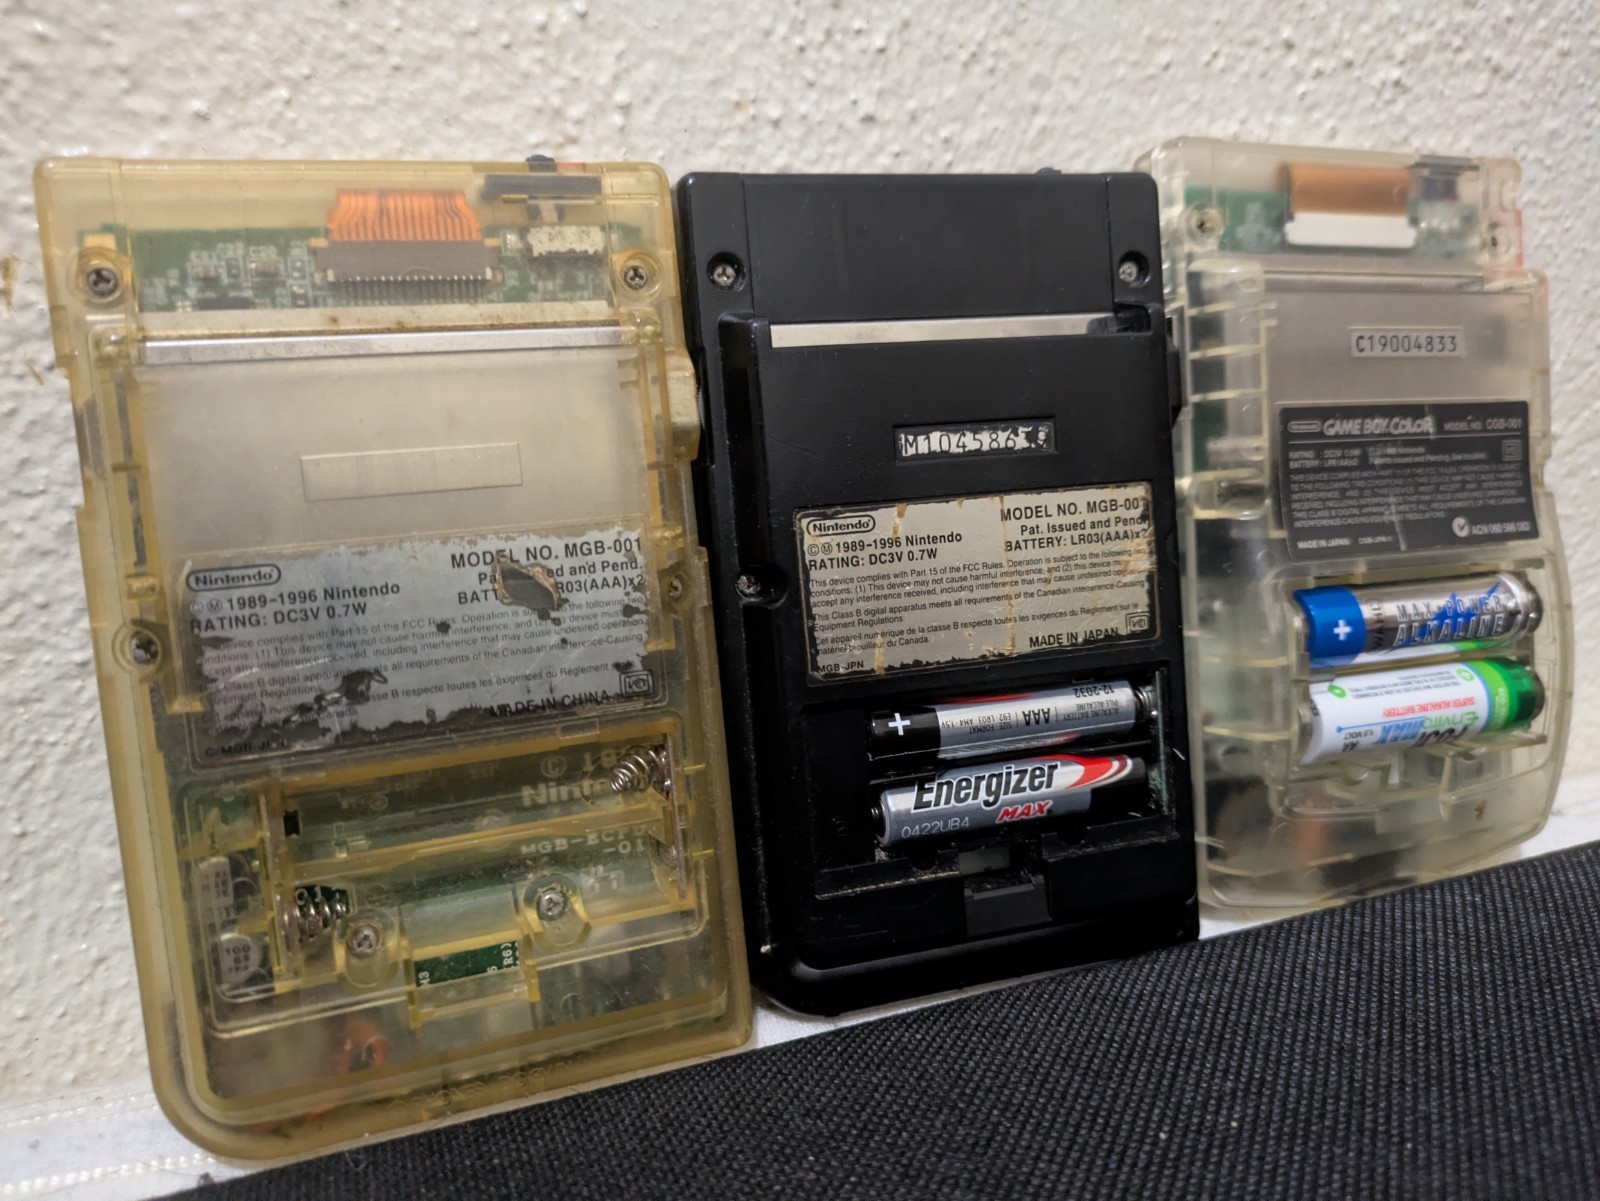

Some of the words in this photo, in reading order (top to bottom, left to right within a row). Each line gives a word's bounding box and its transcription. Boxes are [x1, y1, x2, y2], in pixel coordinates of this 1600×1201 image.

[1356, 335, 1457, 353] C19004833
[1000, 504, 1052, 521] MODEL
[1056, 501, 1081, 516] NO.
[1086, 496, 1140, 513] MGB-00
[812, 518, 869, 532] Nintendo
[1020, 523, 1043, 535] Pat.
[1047, 519, 1085, 533] Issued
[1089, 516, 1110, 529] and
[525, 543, 558, 561] NO.
[564, 536, 641, 558] MGB-001
[835, 536, 901, 553] 1989-1996
[905, 531, 962, 546] Nintendo
[1004, 535, 1066, 552] BATTERY:
[568, 561, 596, 575] and
[601, 556, 643, 573] Pend.
[808, 555, 864, 571] RATING:
[868, 551, 904, 565] DC3V
[907, 548, 937, 561] 0.7W
[194, 568, 272, 588] Nintendo
[829, 575, 854, 585] device
[856, 572, 890, 584] complies
[892, 570, 908, 579] with
[910, 568, 926, 577] Part
[929, 567, 937, 575] 15
[939, 566, 946, 574] of
[949, 565, 960, 573] the
[962, 563, 979, 572] FCC
[868, 582, 884, 591] This
[886, 579, 910, 589] device
[913, 579, 931, 588] may
[931, 576, 943, 585] not
[969, 571, 997, 581] harmful
[226, 588, 317, 611] 1989-1996
[322, 579, 400, 601] Nintendo
[457, 587, 499, 605] BATT
[554, 572, 644, 596] R03(AAA)x2
[940, 583, 973, 595] including
[1021, 577, 1034, 586] that
[831, 609, 853, 619] Class
[855, 608, 861, 617] B
[863, 605, 886, 617] digital
[888, 602, 926, 614] apparatus
[928, 598, 951, 609] meets
[953, 597, 962, 606] all
[1014, 591, 1021, 599] of
[1023, 589, 1034, 598] the
[189, 611, 267, 634] RATING:
[273, 605, 320, 625] DC3V
[325, 600, 367, 619] 0.7W
[402, 618, 424, 629] FCC
[906, 626, 916, 635] de
[918, 625, 924, 634] la
[926, 622, 951, 633] classe
[952, 621, 958, 630] B
[960, 618, 992, 630] respecte
[1018, 613, 1029, 622] les
[1069, 608, 1078, 616] du
[886, 638, 896, 647] du
[1029, 633, 1063, 648] MADE
[1066, 631, 1078, 643] IN
[1083, 627, 1118, 641] JAPAN
[1073, 684, 1115, 698] 12-2032
[1022, 707, 1051, 727] AAA
[969, 725, 995, 734] FORMAT
[911, 761, 1061, 813] Energizer
[996, 800, 1053, 824] MAX
[901, 816, 970, 839] 0422UB4
